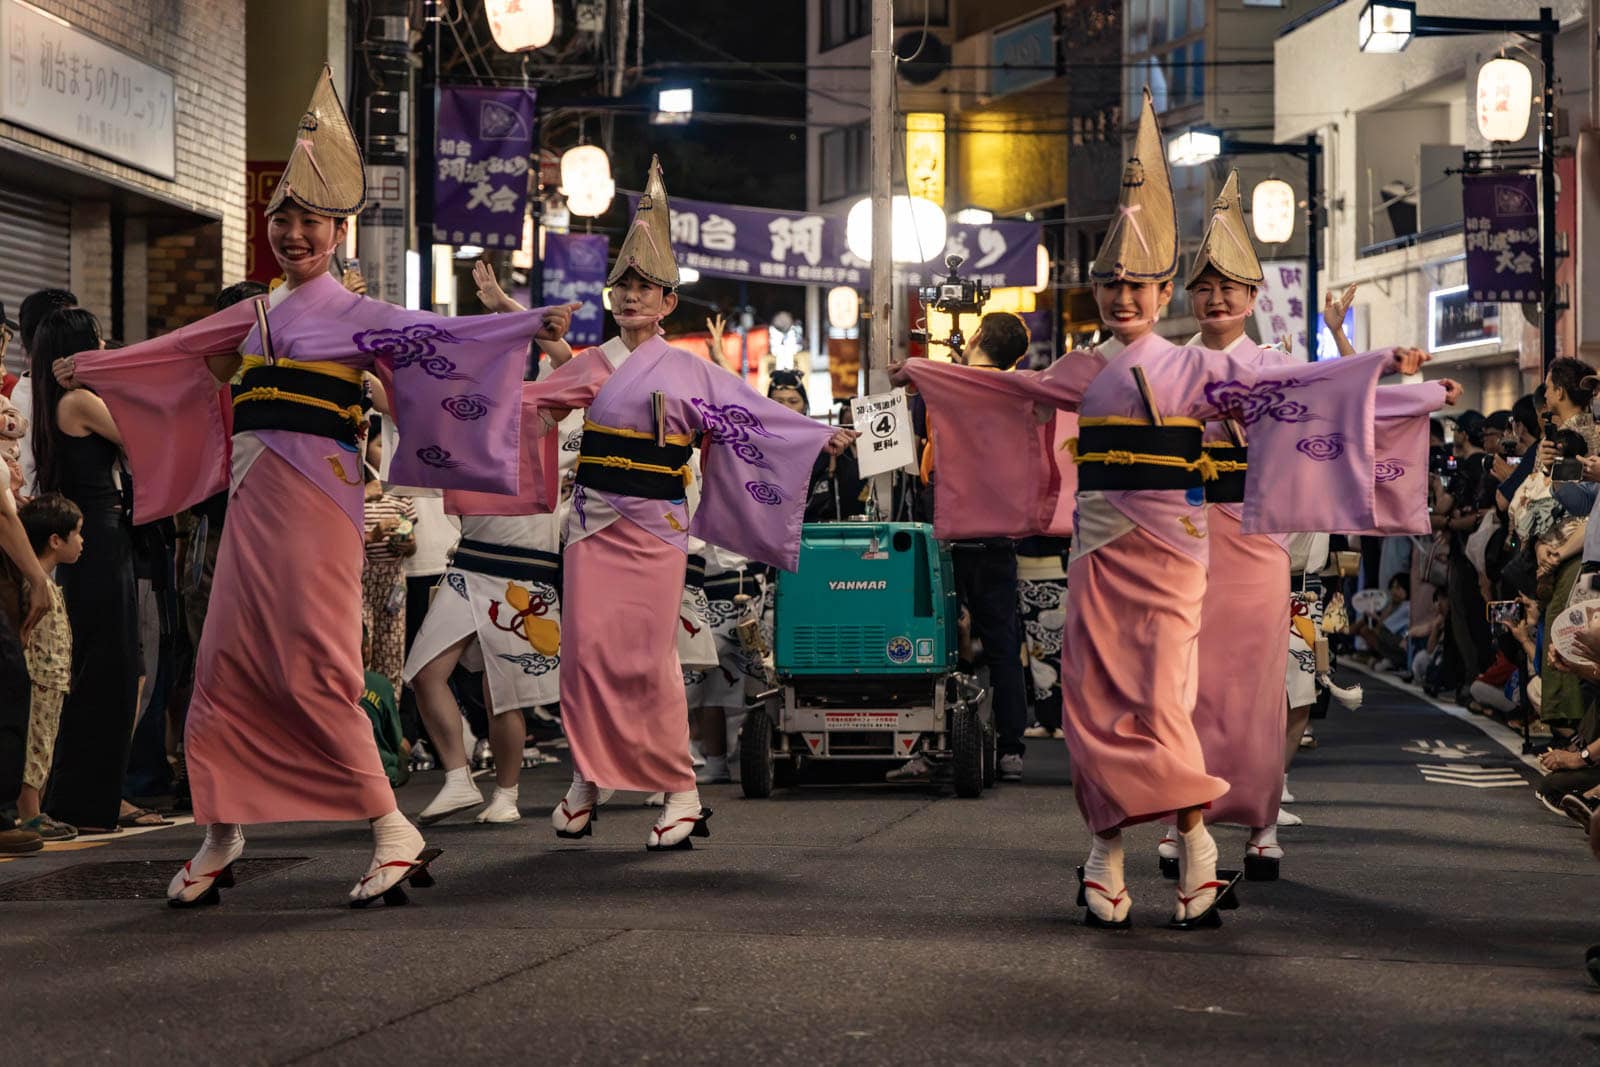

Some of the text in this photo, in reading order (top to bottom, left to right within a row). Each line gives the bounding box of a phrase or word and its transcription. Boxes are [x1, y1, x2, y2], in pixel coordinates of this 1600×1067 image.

[465, 181, 519, 213] 大会
[1495, 250, 1535, 274] 大会
[828, 580, 887, 590] YANMAR
